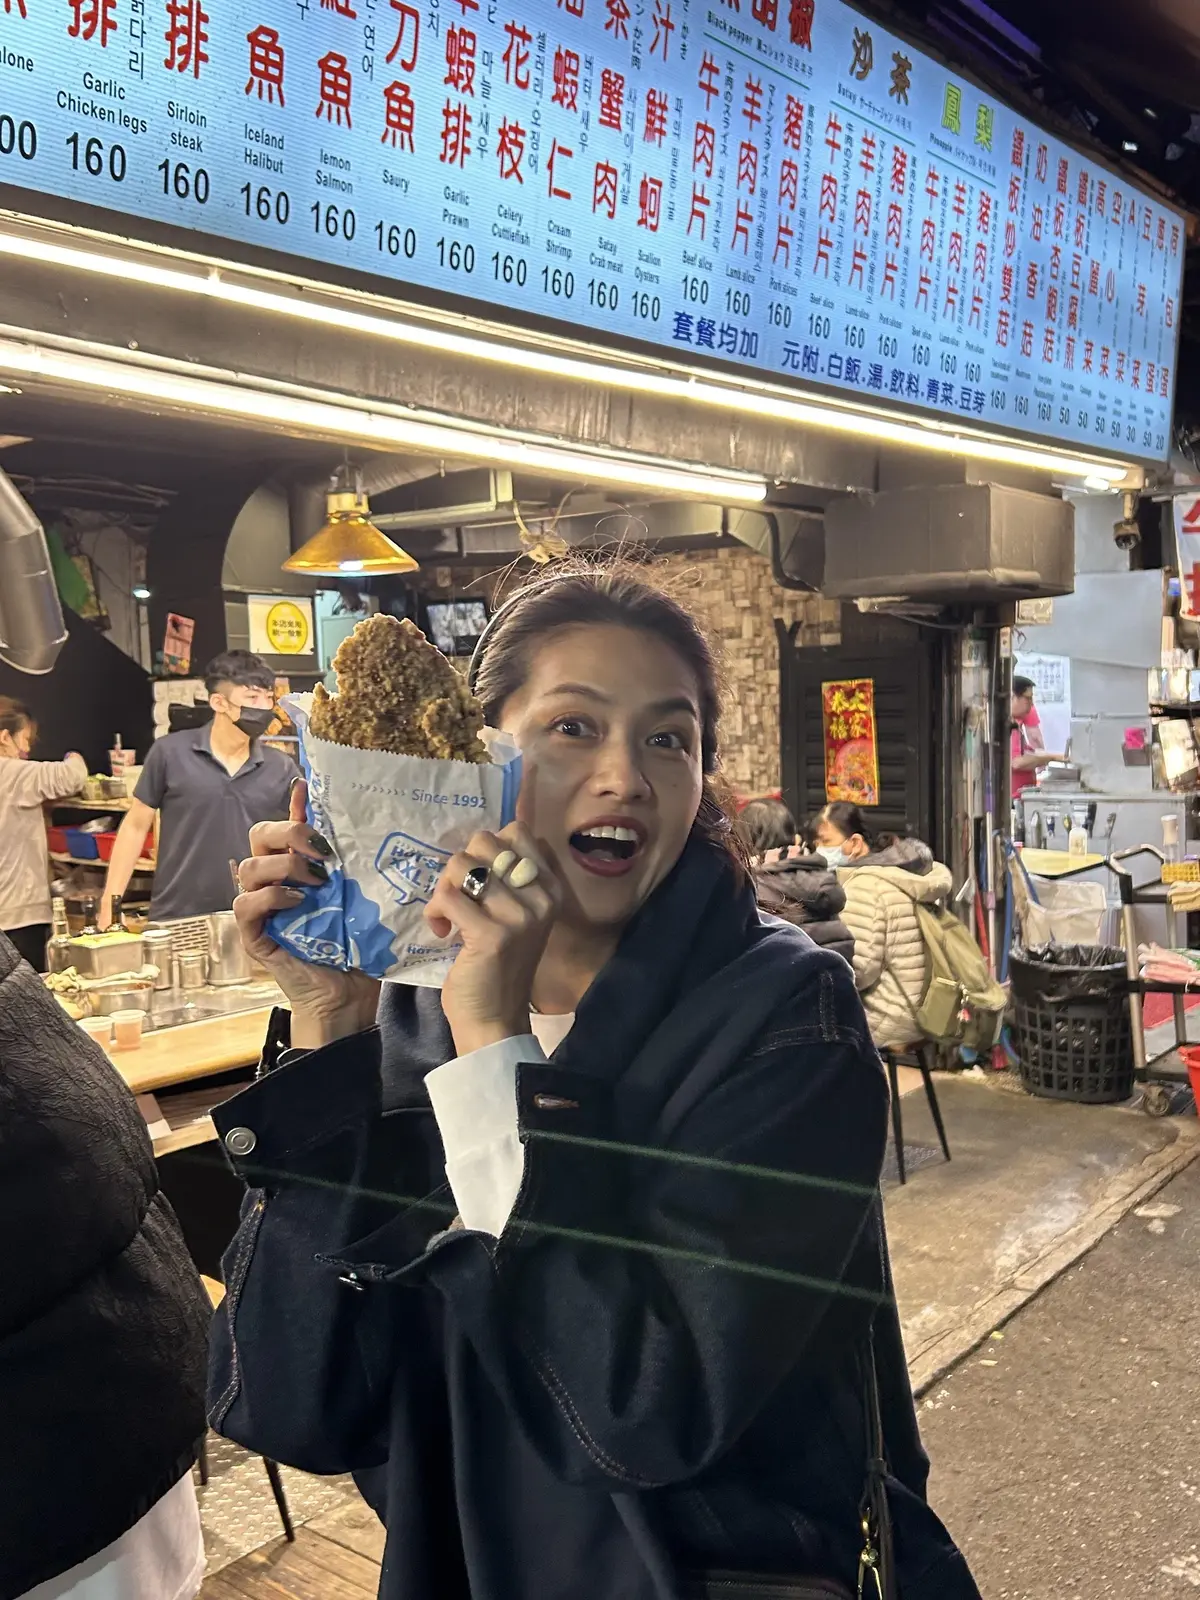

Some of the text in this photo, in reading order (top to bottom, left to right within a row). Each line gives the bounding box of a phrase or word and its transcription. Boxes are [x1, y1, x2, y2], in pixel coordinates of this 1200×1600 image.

[707, 11, 753, 44] Black pepper
[0, 46, 34, 72] lone
[245, 24, 285, 108] 魚
[849, 26, 912, 105] 沙茶
[83, 72, 126, 100] Garlic
[440, 0, 479, 169] 蝦排
[57, 90, 148, 134] Chicken legs
[167, 101, 207, 128] Sirloin
[497, 20, 533, 184] 花枝
[941, 82, 994, 152] 鳳梨
[171, 129, 203, 153] steak
[244, 123, 285, 150] Iceland
[686, 49, 720, 241] 牛肉片
[66, 132, 126, 182] 160
[244, 148, 284, 174] Halibut
[320, 148, 351, 172] lemon
[731, 72, 763, 256] 羊肉片
[158, 158, 210, 205] 160
[315, 170, 353, 195] Salmon
[382, 169, 410, 193] Saury
[772, 93, 804, 269] 豬肉片
[813, 110, 842, 279] 牛肉片
[241, 182, 289, 225] 160
[443, 186, 470, 206] Garlic
[848, 128, 876, 291] 羊肉片
[311, 200, 355, 241] 160
[442, 208, 470, 229] Prawn
[498, 204, 523, 226] Celery
[880, 144, 907, 301] 豬肉片
[374, 220, 416, 258] 160
[548, 220, 572, 238] Cream
[914, 162, 940, 313] 牛肉片
[437, 236, 475, 273] 160
[546, 239, 572, 260] Shrimp
[598, 237, 617, 256] Satay
[943, 176, 966, 322] 羊肉片
[968, 189, 991, 331] 豬肉片
[492, 251, 527, 287] 160
[607, 259, 624, 275] meat
[541, 265, 574, 299] 160
[588, 278, 618, 311] 160
[682, 275, 709, 304] 160
[1099, 189, 1122, 379] 空心菜
[632, 291, 661, 322] 160
[725, 287, 750, 316] 160
[768, 301, 792, 328] 160
[671, 310, 758, 359] 套餐均加
[808, 313, 830, 339] 160
[844, 324, 865, 348] 160
[878, 333, 898, 358] 160
[912, 342, 930, 367] 160
[940, 351, 957, 375] 160
[965, 360, 981, 383] 160
[991, 388, 1006, 410] 160
[1014, 394, 1028, 416] 160
[1038, 402, 1052, 421] 160
[1059, 406, 1070, 425] 50
[1078, 410, 1088, 429] 50
[1095, 416, 1105, 434] 50
[1111, 421, 1121, 438] 50
[1126, 425, 1136, 443] 30
[1155, 434, 1164, 451] 20
[411, 788, 487, 809] Since 1992
[388, 858, 421, 886] XXL
